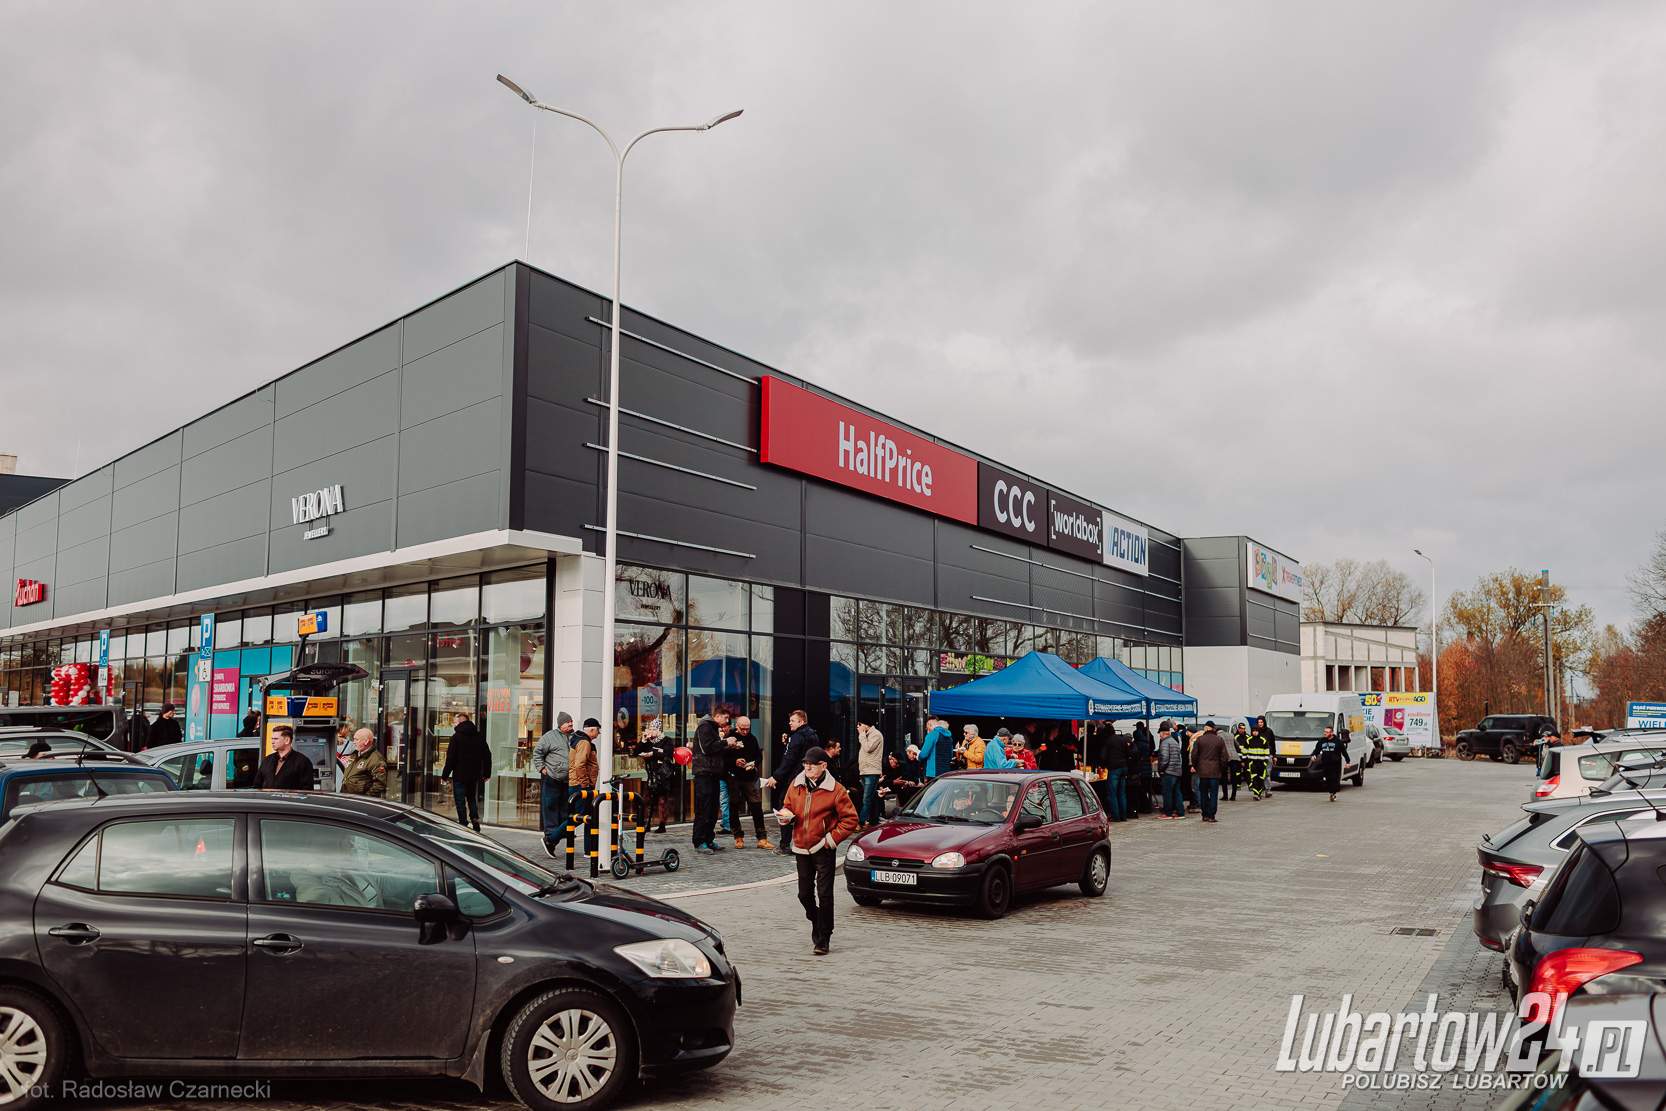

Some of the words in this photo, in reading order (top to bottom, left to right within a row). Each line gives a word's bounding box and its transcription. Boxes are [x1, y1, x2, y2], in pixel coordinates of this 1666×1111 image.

[839, 421, 933, 496] HalfPrice
[292, 485, 343, 524] VERONA
[994, 480, 1035, 532] CCC
[1110, 527, 1146, 566] ACTION
[629, 580, 672, 600] VERONA
[203, 619, 211, 646] P
[1409, 718, 1423, 727] 749
[892, 873, 916, 884] 09071
